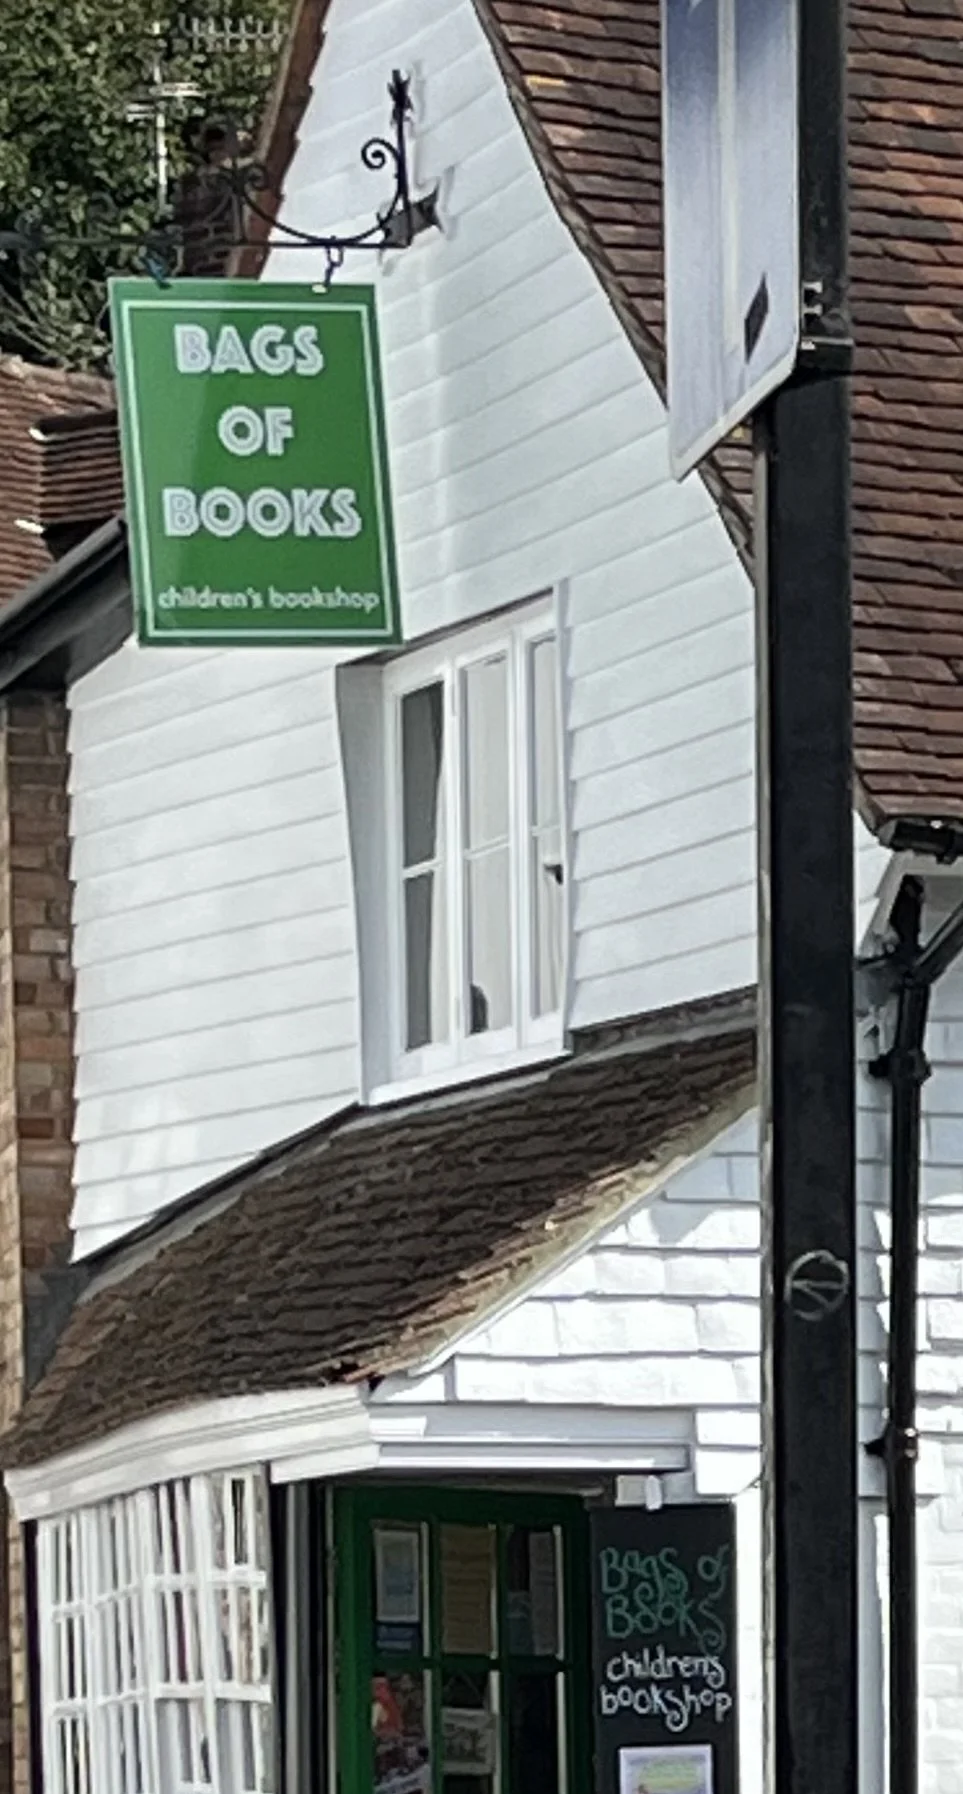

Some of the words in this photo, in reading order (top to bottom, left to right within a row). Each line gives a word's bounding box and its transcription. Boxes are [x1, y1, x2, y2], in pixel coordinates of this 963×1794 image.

[173, 323, 324, 376] BAGS
[217, 405, 294, 457] OF
[161, 486, 362, 538] BOOKS
[158, 586, 263, 609] children's
[269, 585, 380, 614] bookshop
[600, 1546, 689, 1606] Bags
[601, 1684, 733, 1732] bookshop
